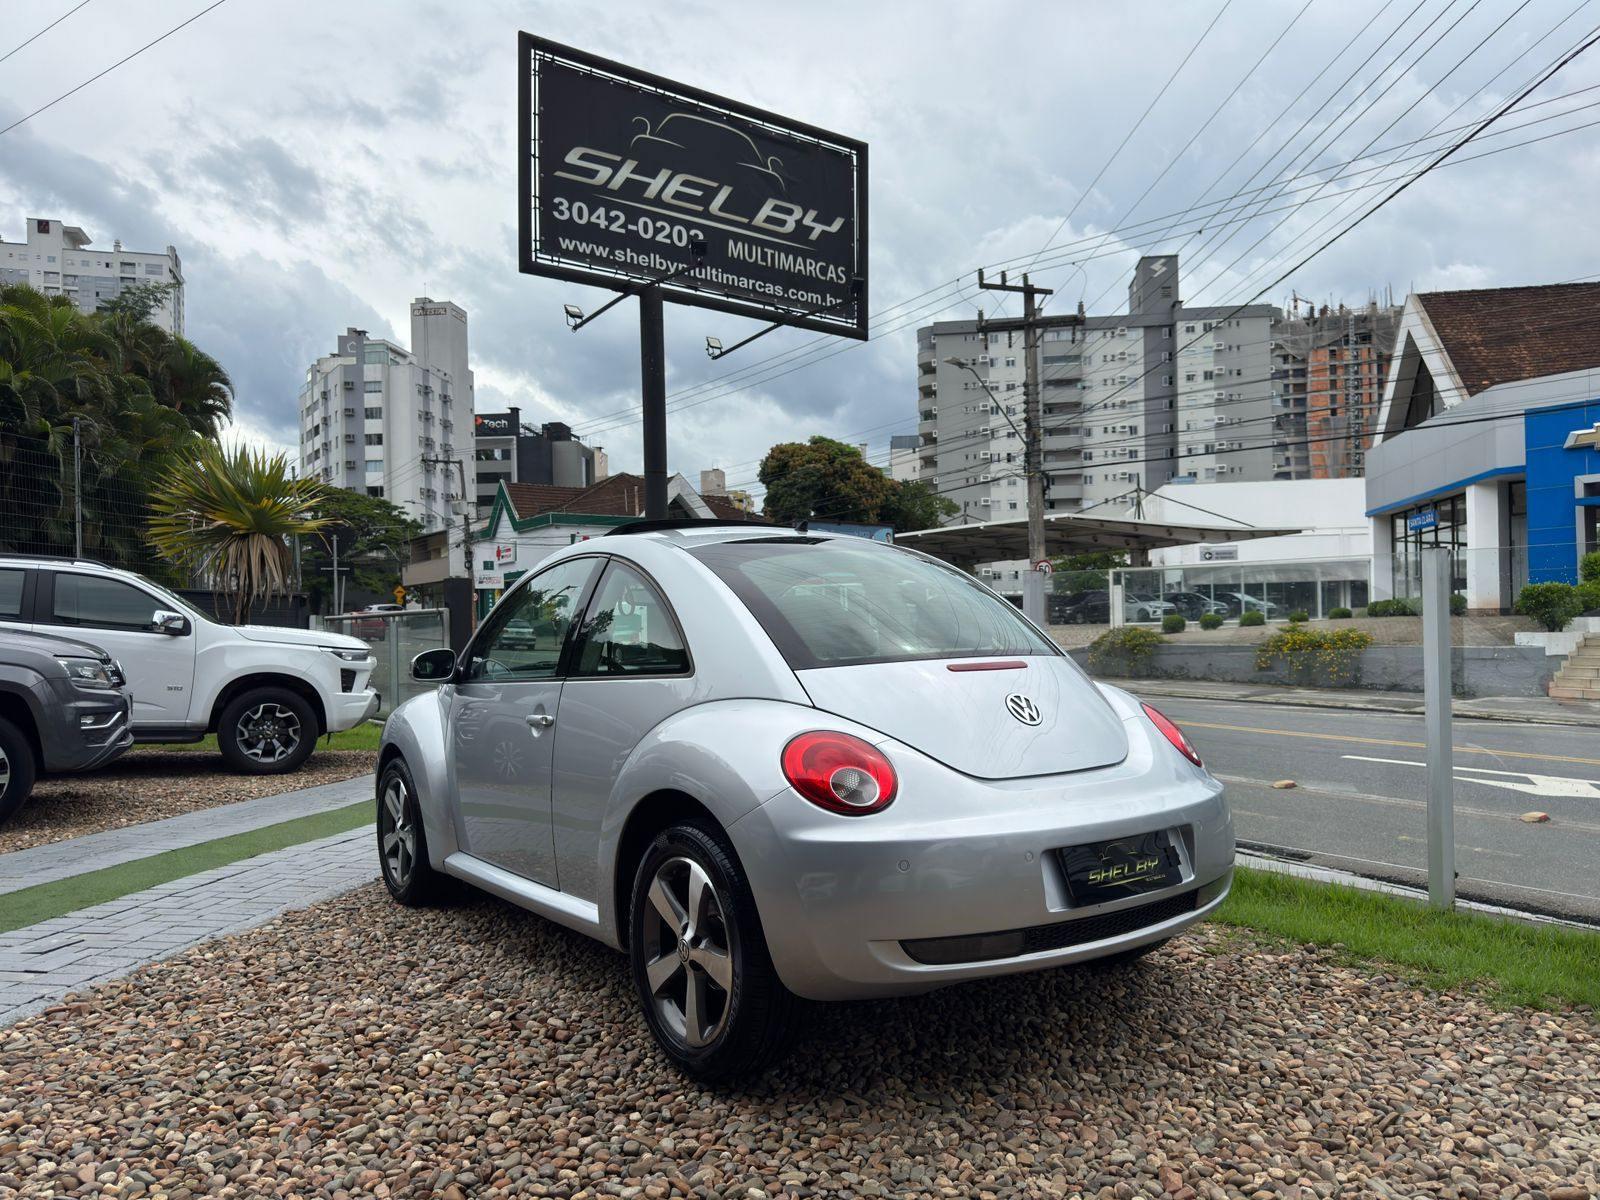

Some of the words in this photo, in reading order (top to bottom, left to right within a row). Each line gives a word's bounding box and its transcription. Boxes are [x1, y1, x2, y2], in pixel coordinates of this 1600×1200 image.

[553, 146, 846, 240] SHELBY
[727, 238, 847, 284] MULTIMARCAS
[1088, 857, 1159, 885] SHELBY
